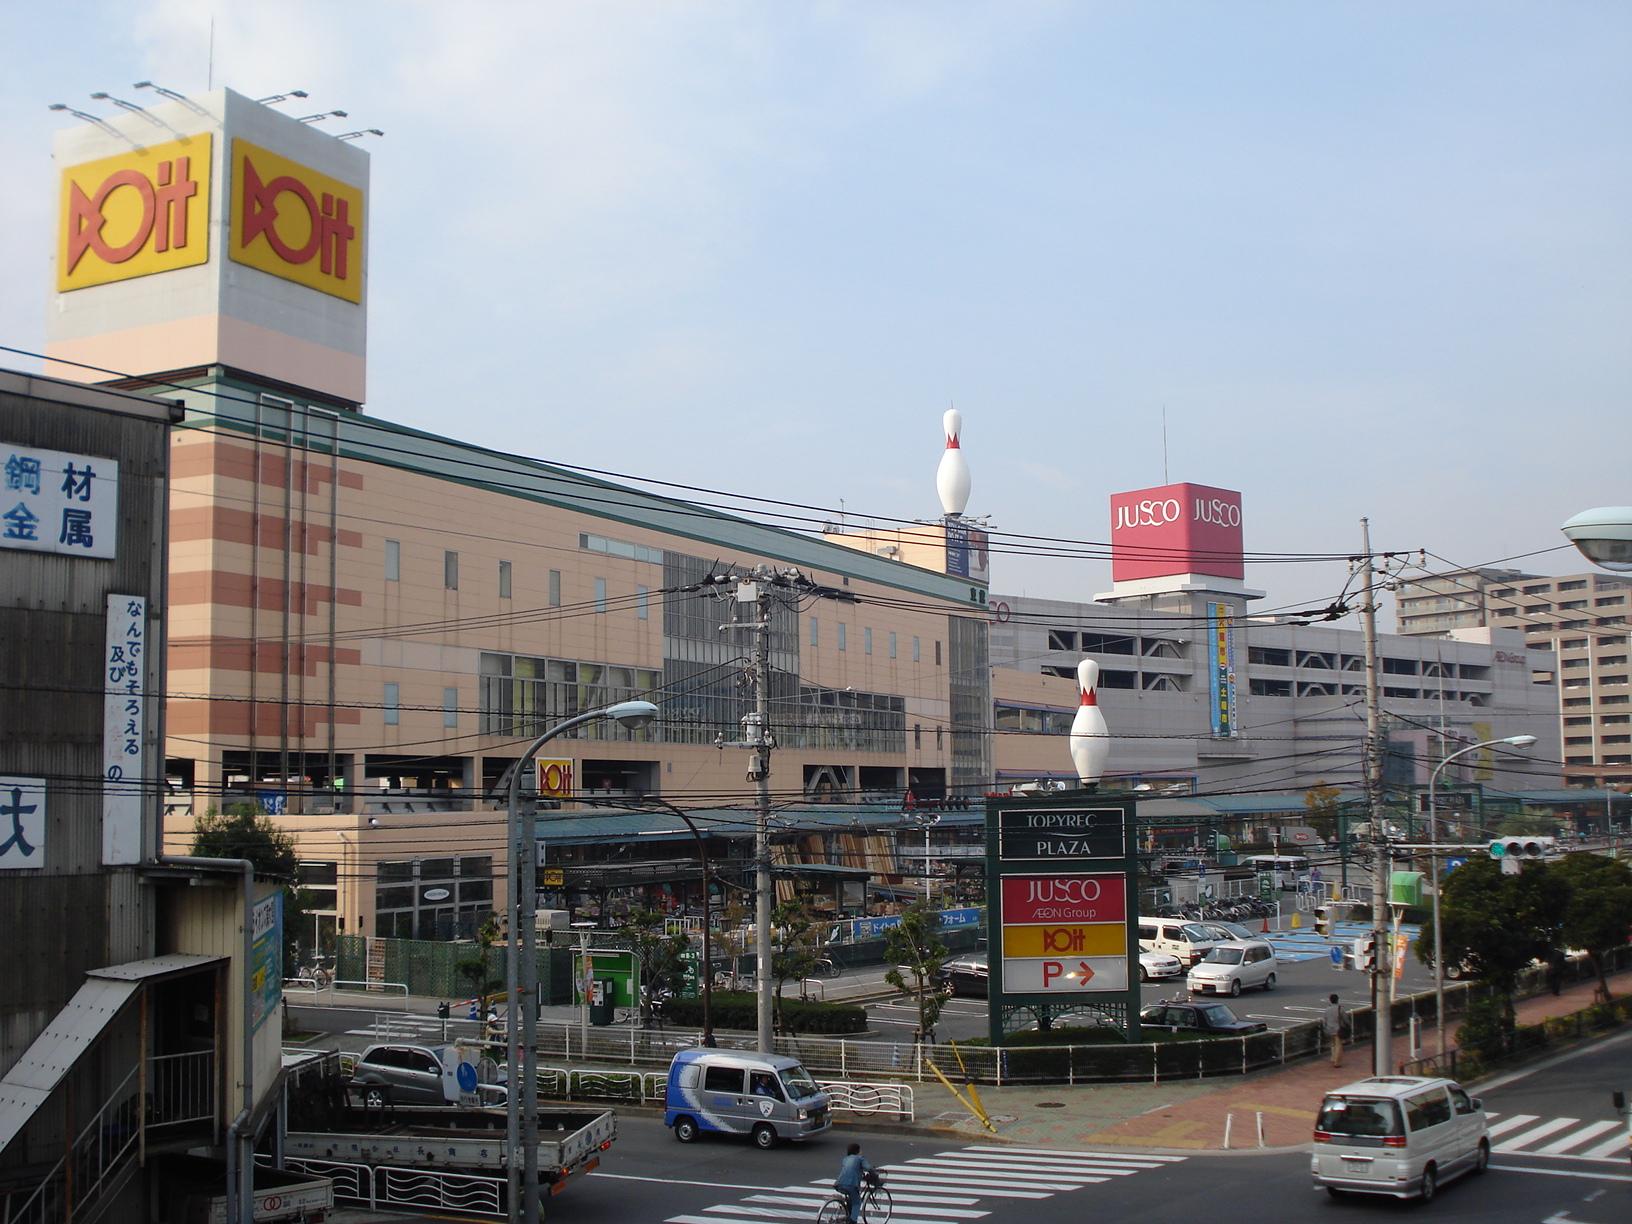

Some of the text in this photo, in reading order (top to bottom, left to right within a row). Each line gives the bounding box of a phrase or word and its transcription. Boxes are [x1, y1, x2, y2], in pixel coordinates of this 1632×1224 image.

[2, 501, 95, 548] 金属
[1115, 498, 1181, 530] JUSCO
[1193, 498, 1241, 528] JUSCO
[124, 600, 142, 755] なんでもそろえる
[1026, 813, 1098, 828] TOPYREC
[1036, 840, 1092, 856] PLAZA
[1026, 879, 1101, 904] JUSCO
[1063, 907, 1097, 919] Group
[1043, 961, 1064, 988] P
